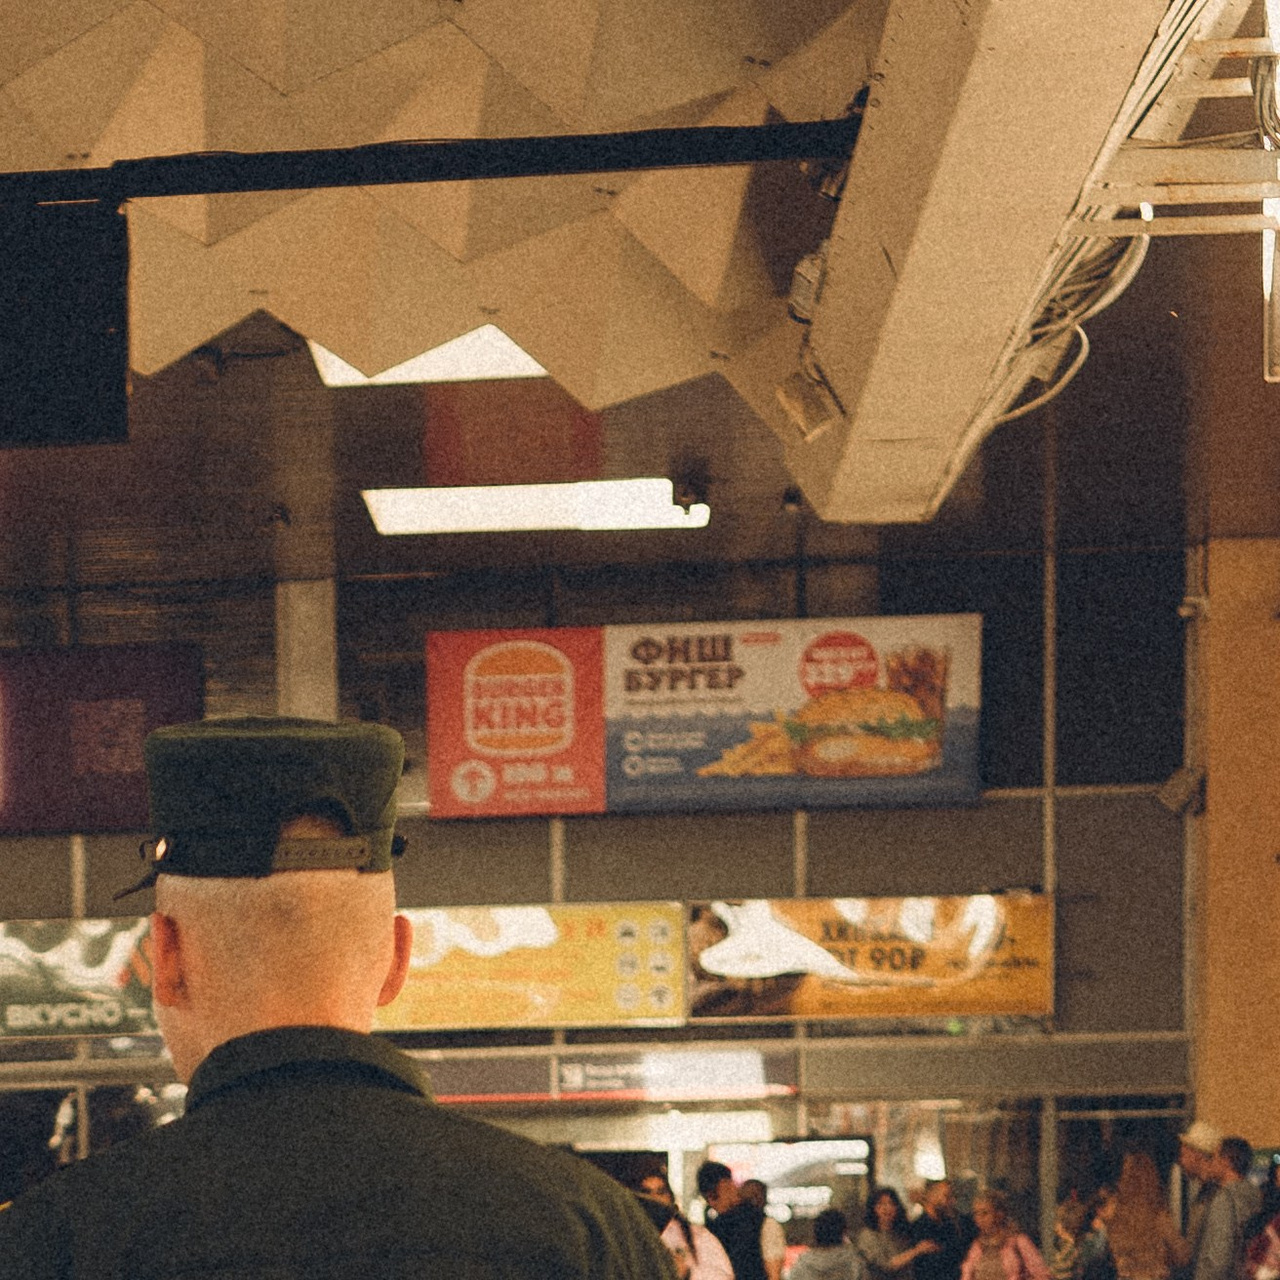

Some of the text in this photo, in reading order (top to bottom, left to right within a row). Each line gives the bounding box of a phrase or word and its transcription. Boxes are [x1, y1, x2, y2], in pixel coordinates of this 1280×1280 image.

[630, 634, 732, 664] ФИШ
[623, 665, 745, 692] БУРГЕР
[473, 698, 566, 730] KING
[7, 1002, 122, 1028] ВКУСНО
